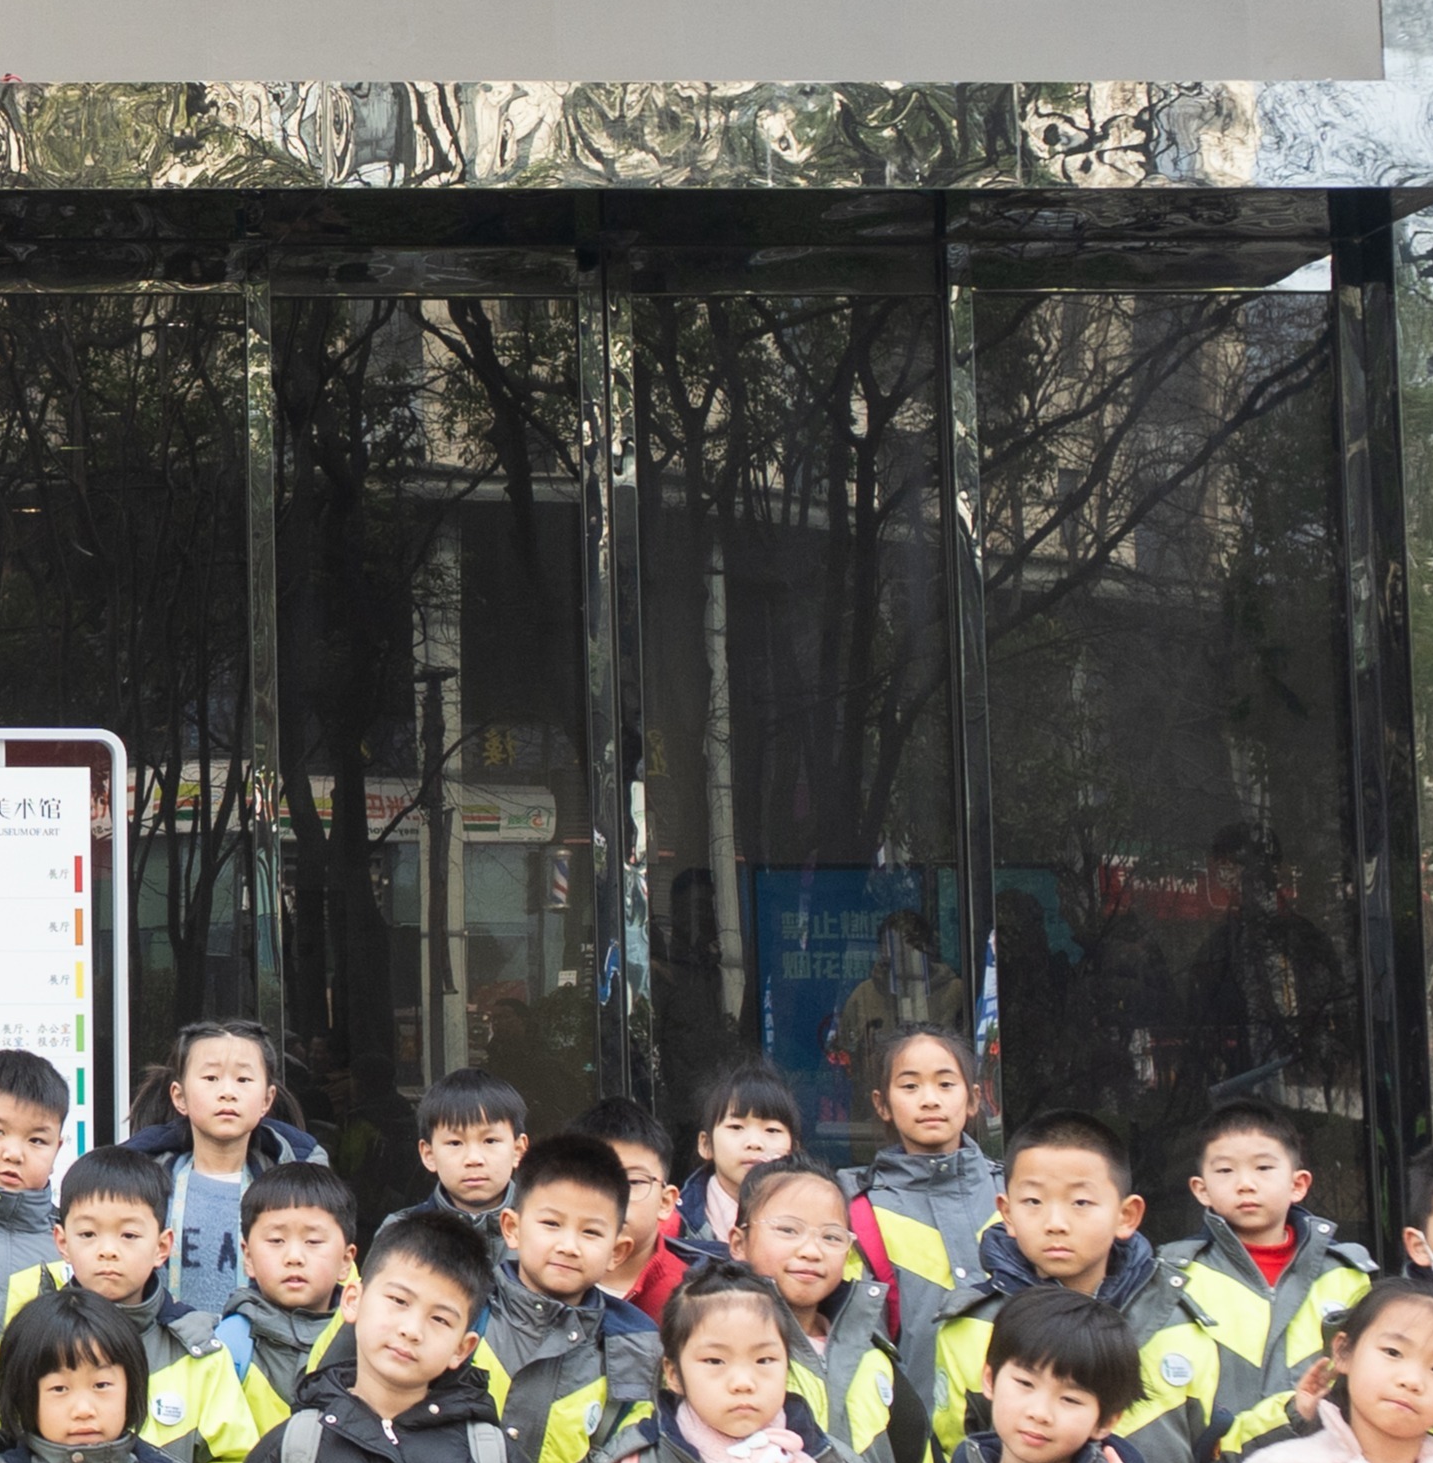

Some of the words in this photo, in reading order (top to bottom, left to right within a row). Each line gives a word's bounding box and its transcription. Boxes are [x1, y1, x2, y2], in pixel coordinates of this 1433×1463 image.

[29, 827, 42, 837] OF
[41, 827, 61, 837] ART
[48, 869, 70, 880] 展厅
[48, 921, 70, 933] 展厅
[782, 951, 879, 979] 烟花爆
[48, 974, 71, 986] 展厅
